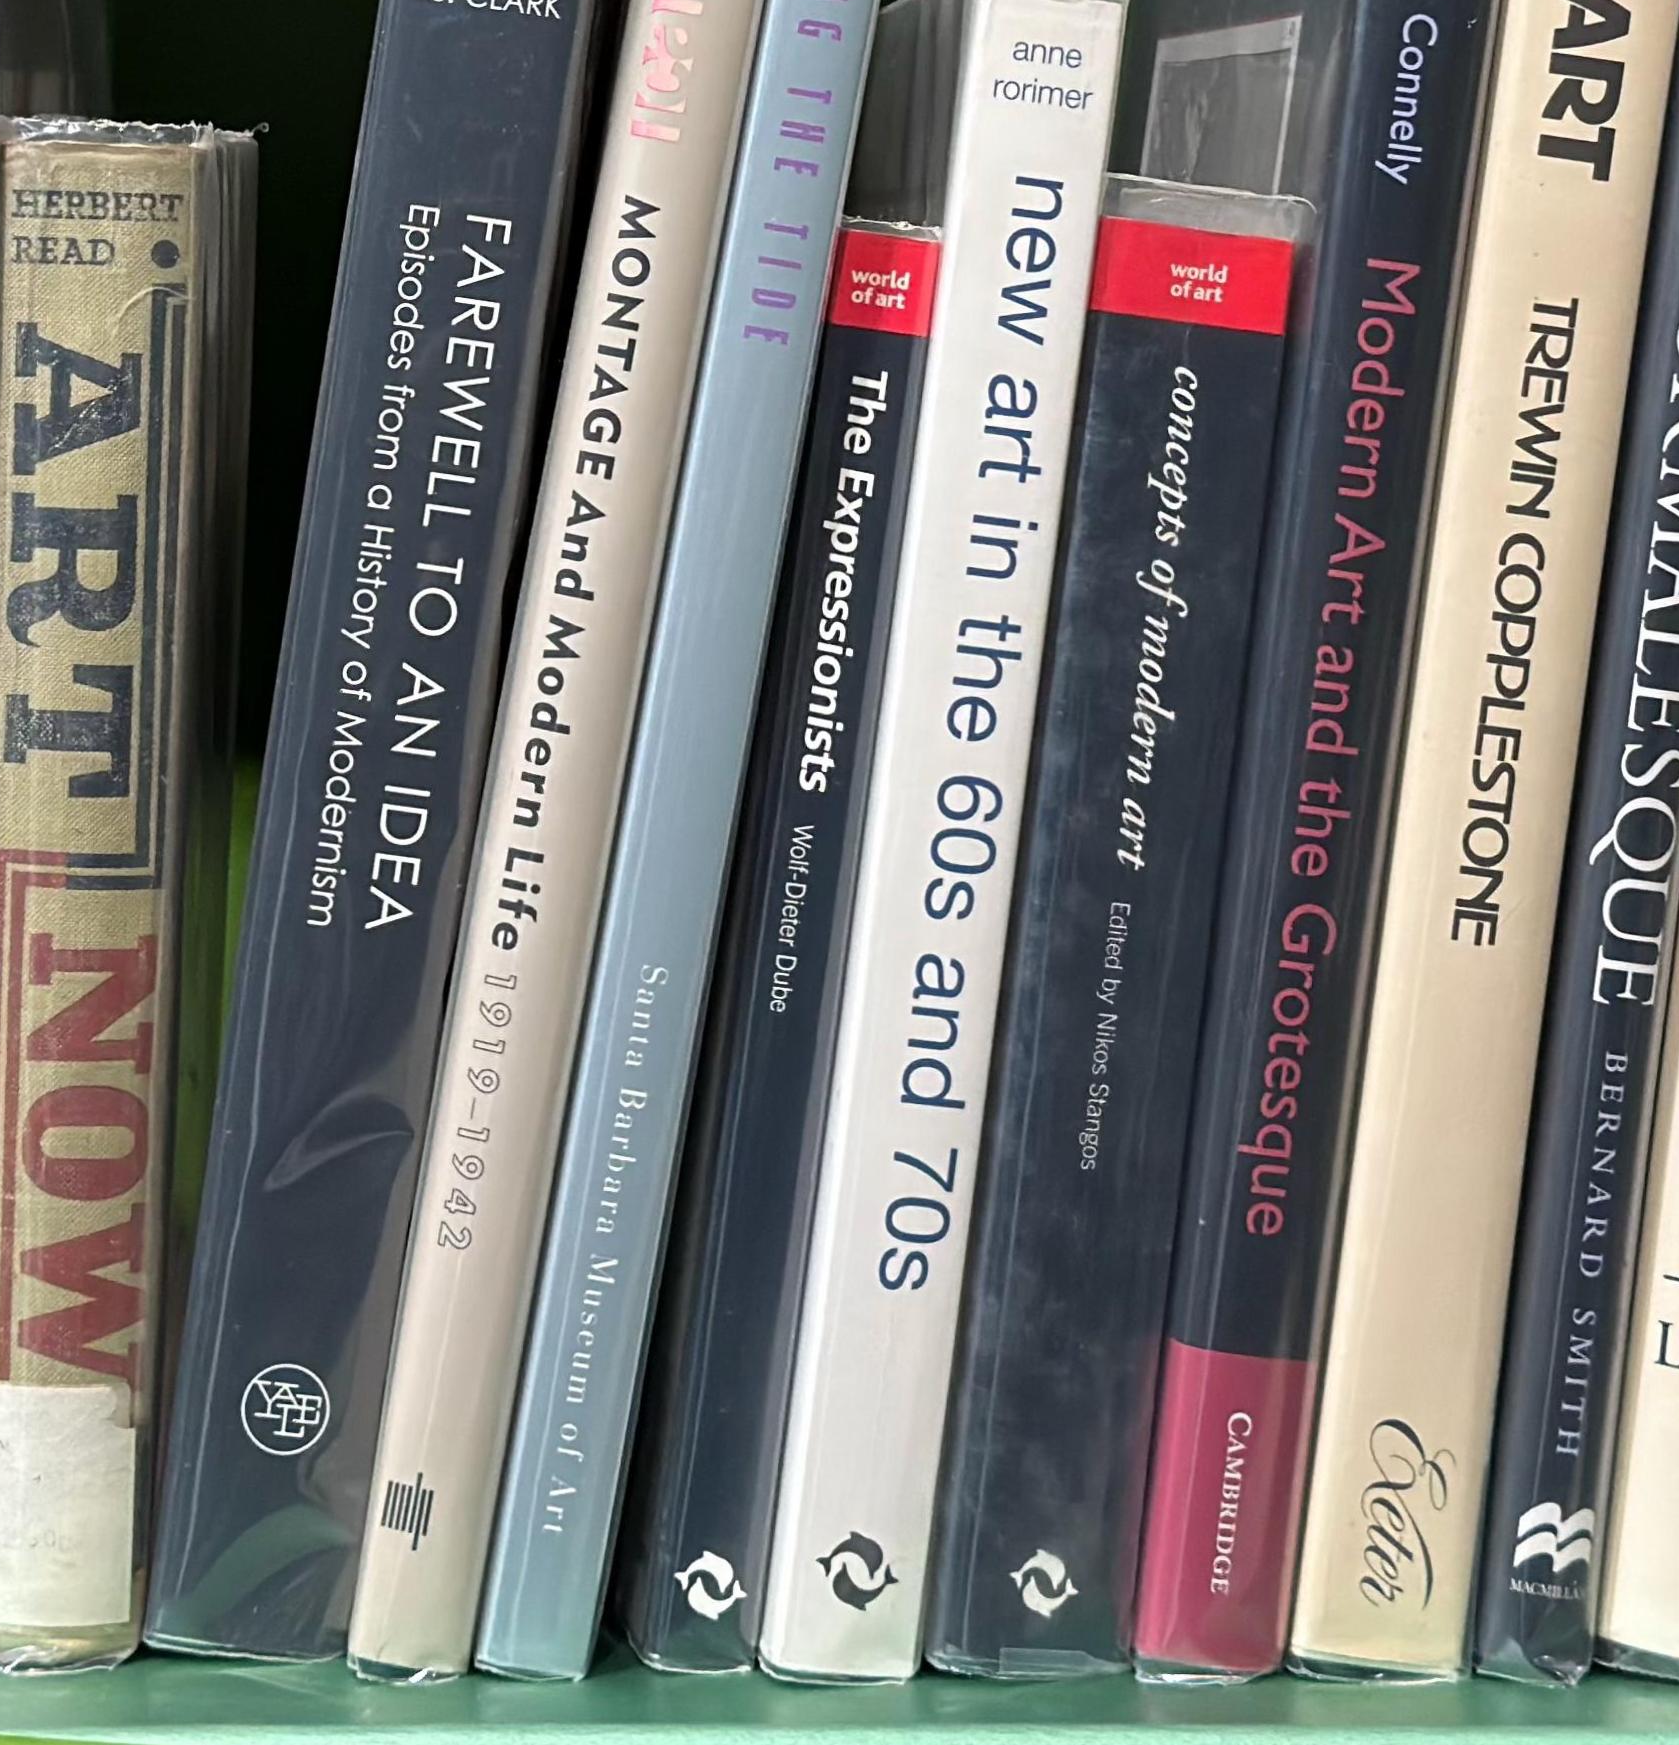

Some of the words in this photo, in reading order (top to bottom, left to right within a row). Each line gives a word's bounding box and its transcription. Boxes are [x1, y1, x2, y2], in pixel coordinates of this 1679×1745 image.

[993, 78, 1093, 110] rorimer
[1012, 41, 1082, 68] anne
[1375, 14, 1438, 184] Connelly
[12, 189, 183, 221] HERBERT
[12, 235, 115, 266] READ
[386, 205, 439, 370] Episodes
[575, 195, 660, 480] MONTAGE
[422, 215, 511, 526] FAREWELL
[843, 370, 889, 454] The
[1337, 258, 1420, 498] Modern
[1506, 298, 1578, 518] TREWIN
[372, 385, 416, 470] from
[1147, 366, 1204, 547] concepts
[367, 484, 390, 508] a
[551, 490, 606, 600] And
[4, 322, 143, 800] ART
[341, 524, 392, 648] History
[409, 557, 464, 637] TO
[1135, 559, 1188, 616] of
[1322, 513, 1386, 625] Art
[339, 661, 372, 701] of
[798, 468, 876, 793] Expressionists
[391, 663, 445, 754] AN
[513, 614, 585, 828] Modern
[1125, 614, 1174, 783] modern
[1305, 646, 1358, 756] and
[1451, 533, 1545, 946] COPPLESTONE
[306, 713, 365, 926] Modernism
[365, 785, 428, 930] IDEA
[1116, 798, 1150, 871] art
[1291, 778, 1351, 877] the
[490, 847, 546, 949] Life
[776, 825, 815, 945] Wolf-Dieter
[1102, 902, 1132, 970] Edited
[623, 965, 669, 1067] Santa
[769, 954, 797, 1013] Dube
[1094, 978, 1123, 1005] by
[1090, 1013, 1118, 1074] Nikos
[1237, 903, 1337, 1235] Grotesque
[14, 935, 156, 1424] NOW
[594, 1088, 647, 1234] Barbara
[1079, 1083, 1111, 1170] Stangos
[1577, 1052, 1628, 1279] BERNARD
[565, 1255, 620, 1404] Museum
[1554, 1308, 1597, 1458] SMITH
[556, 1423, 584, 1461] of
[541, 1476, 577, 1535] Art
[1211, 1412, 1253, 1596] CAMBRIDGE
